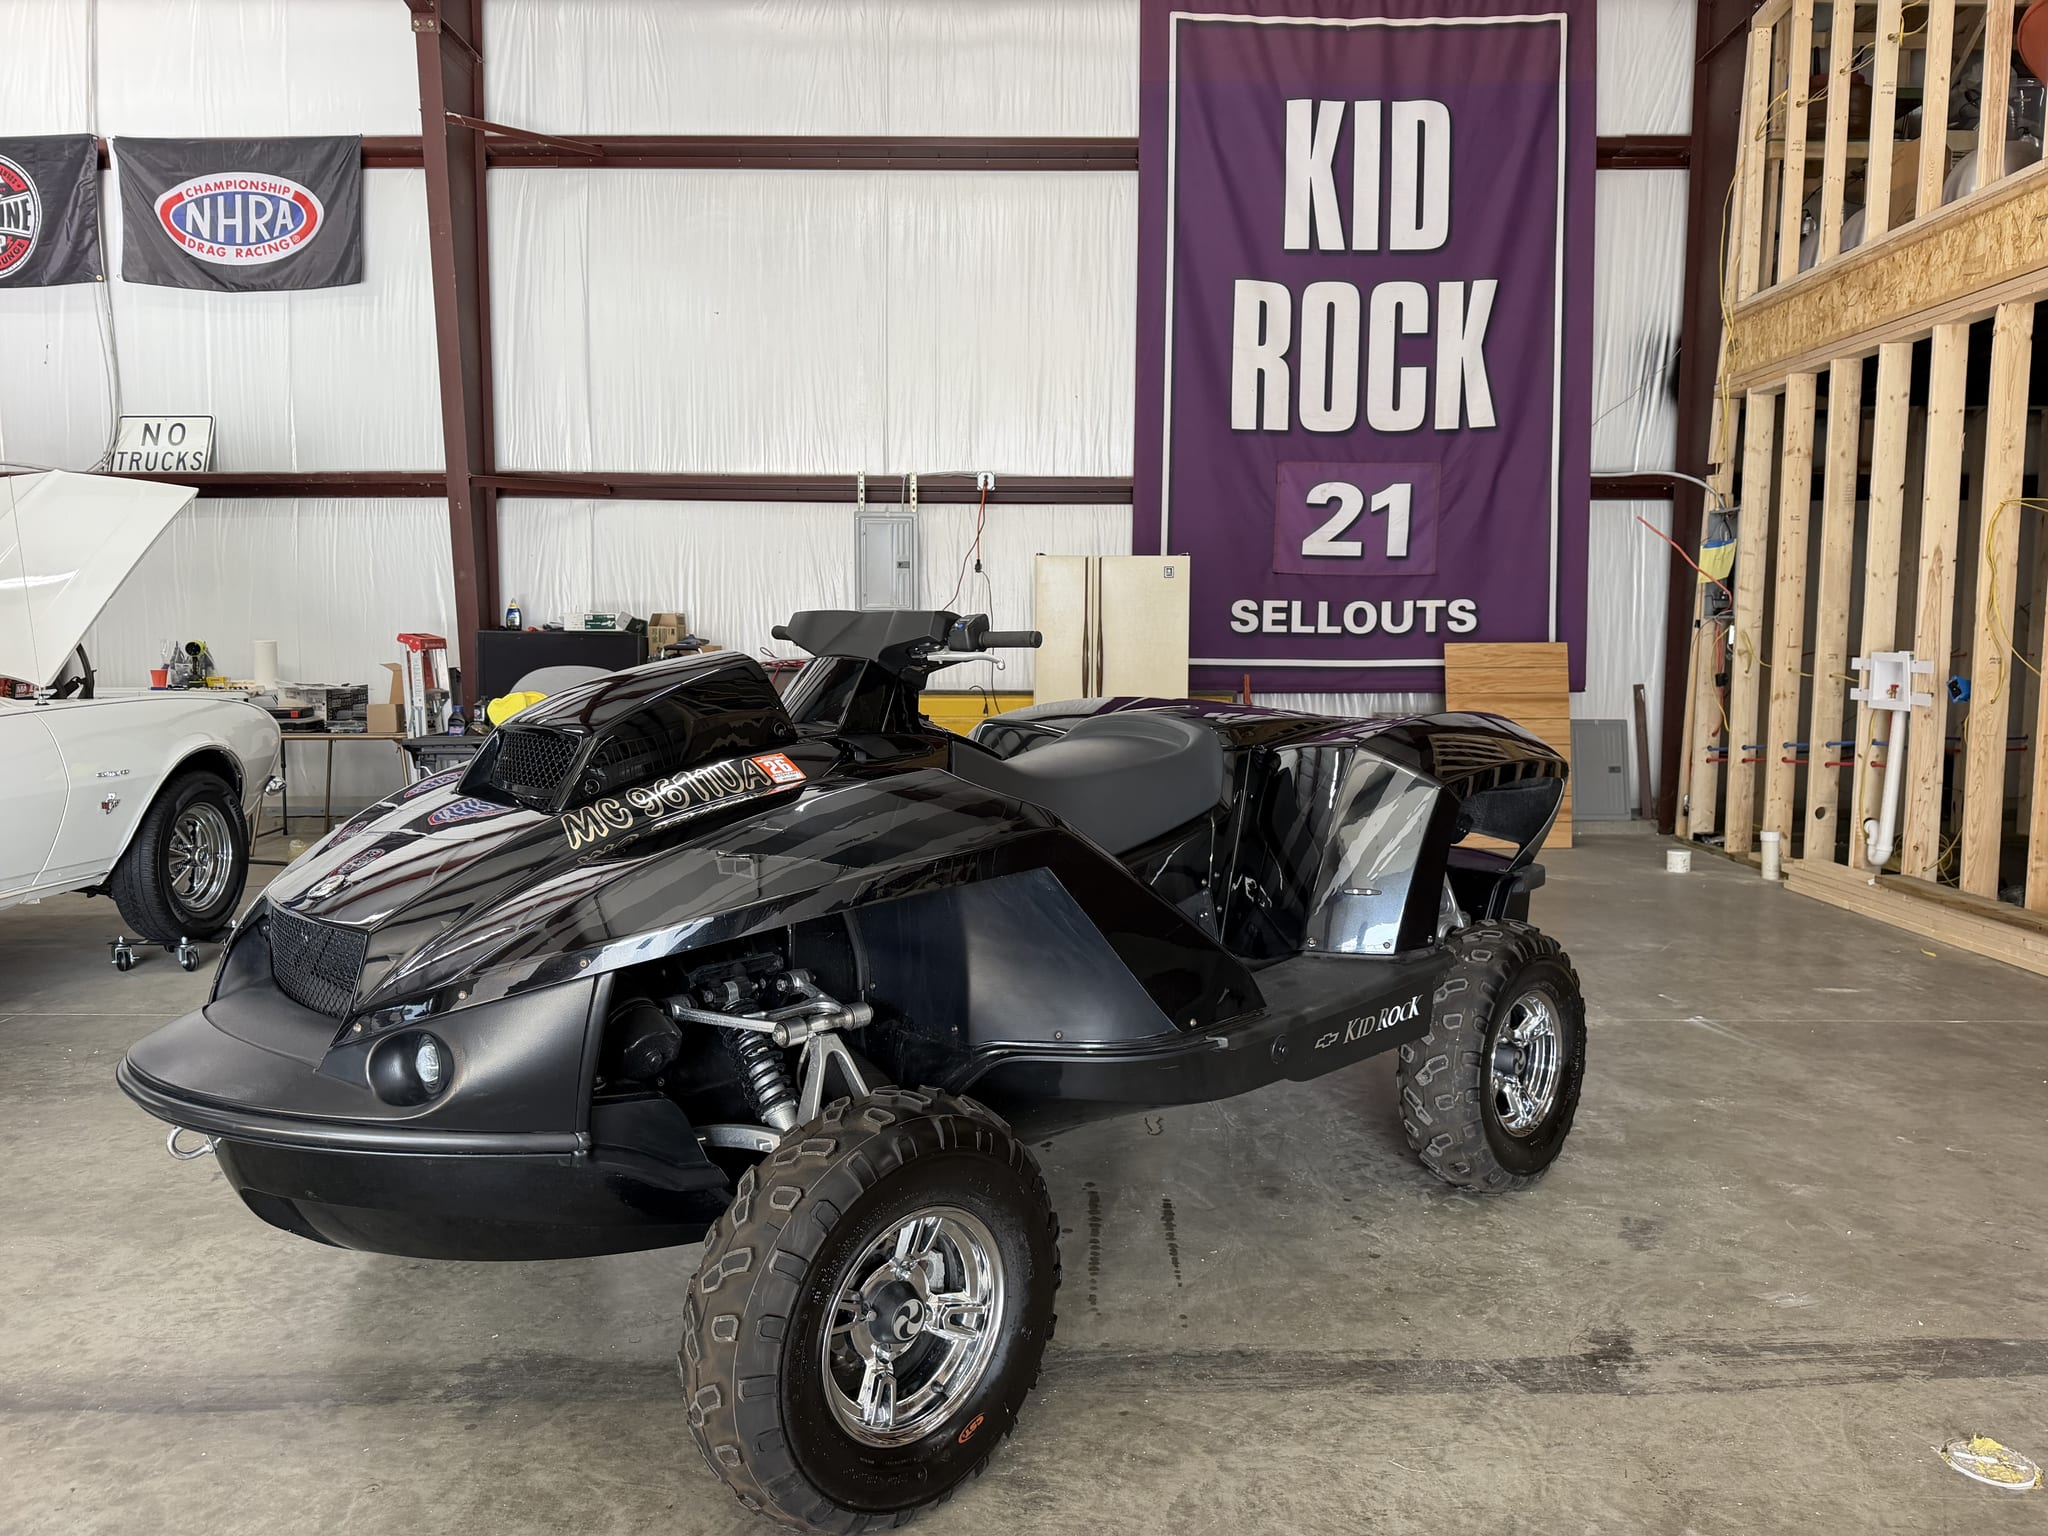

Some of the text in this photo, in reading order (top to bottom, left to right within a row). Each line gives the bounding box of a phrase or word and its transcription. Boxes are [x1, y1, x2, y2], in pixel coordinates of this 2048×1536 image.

[185, 179, 291, 198] CHAMPIONSHIP
[1283, 99, 1451, 251] KID
[185, 193, 295, 244] NHRA
[0, 242, 25, 265] UNGE
[187, 239, 290, 258] DRAG RACING
[1230, 279, 1499, 432] ROCK
[141, 422, 186, 446] NO
[117, 451, 204, 471] TRUCKS
[1301, 480, 1413, 557] 21
[1230, 597, 1479, 635] SELLOUTS
[763, 759, 794, 775] 26
[560, 798, 634, 850] MC
[1343, 994, 1424, 1045] KID ROCK
